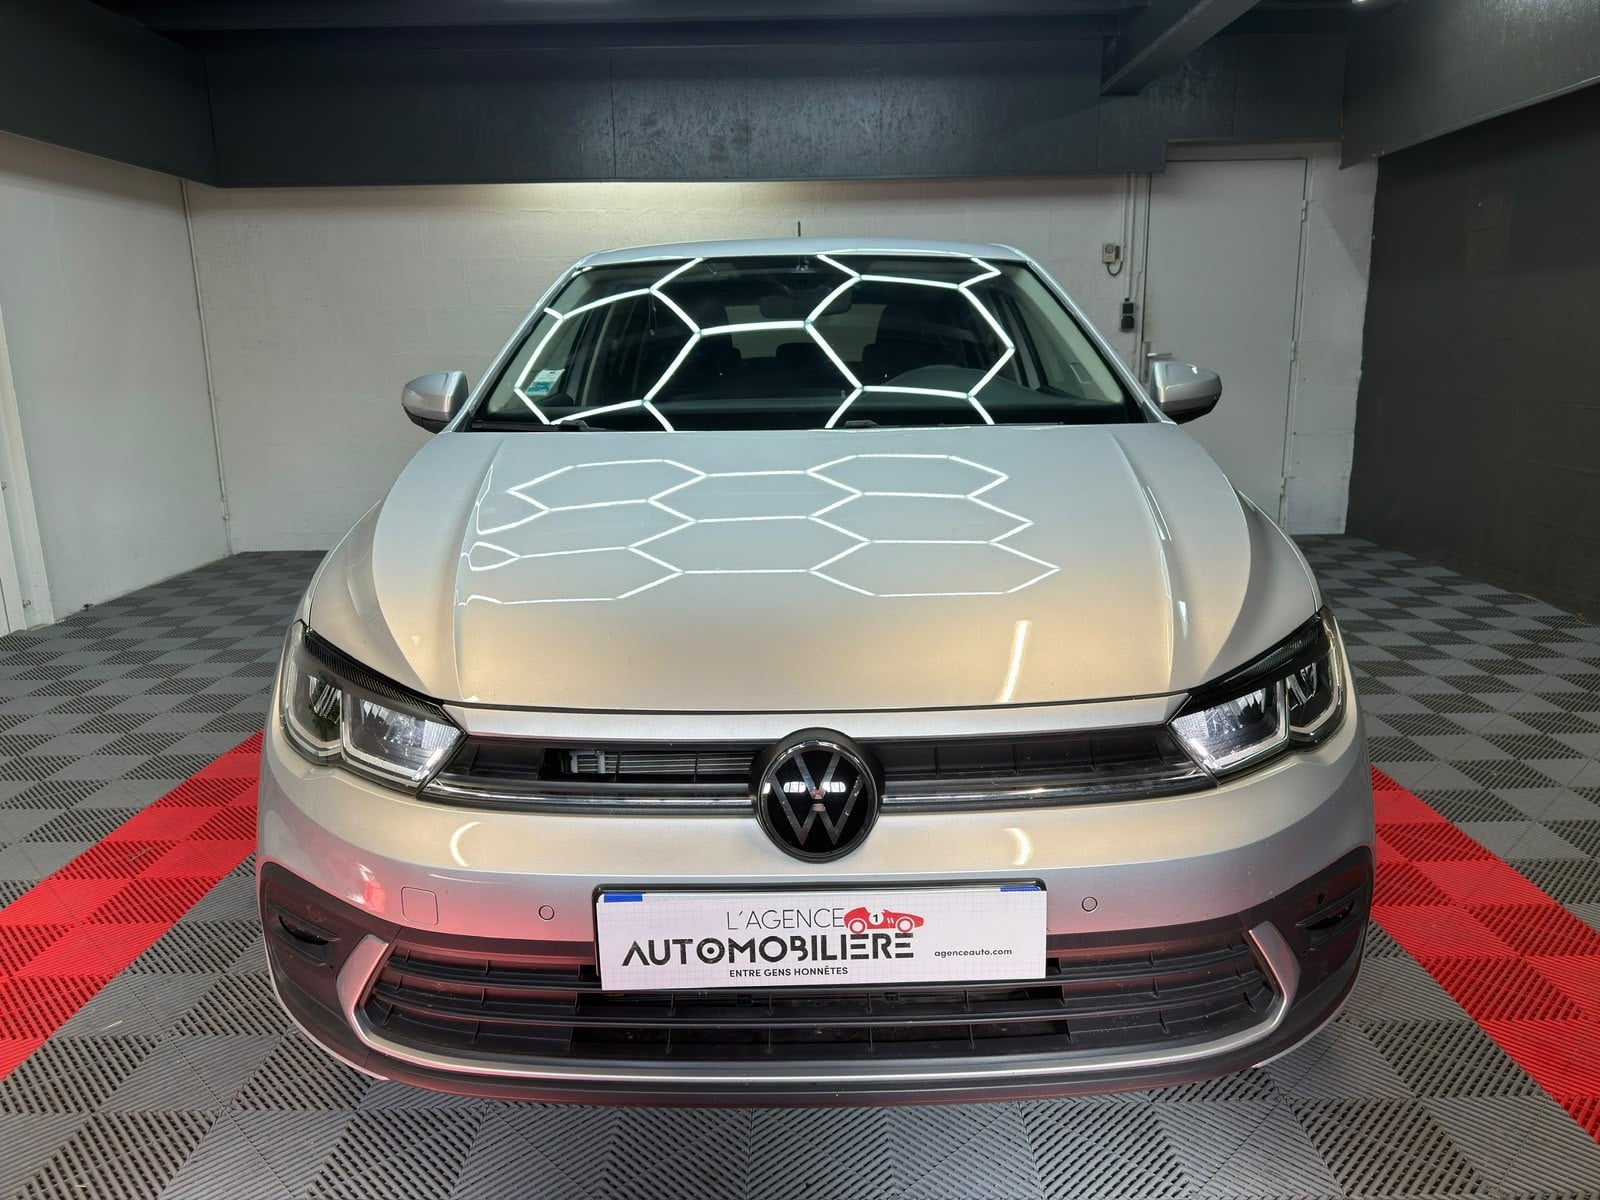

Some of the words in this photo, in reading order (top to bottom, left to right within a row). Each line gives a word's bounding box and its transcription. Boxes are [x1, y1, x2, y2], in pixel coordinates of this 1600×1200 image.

[726, 907, 845, 931] L'AGENCE
[872, 913, 879, 923] 1
[934, 948, 1013, 959] agenceauto.com
[729, 968, 762, 978] ENTRE
[763, 967, 792, 977] GENS
[793, 964, 849, 977] HONNÊTES
